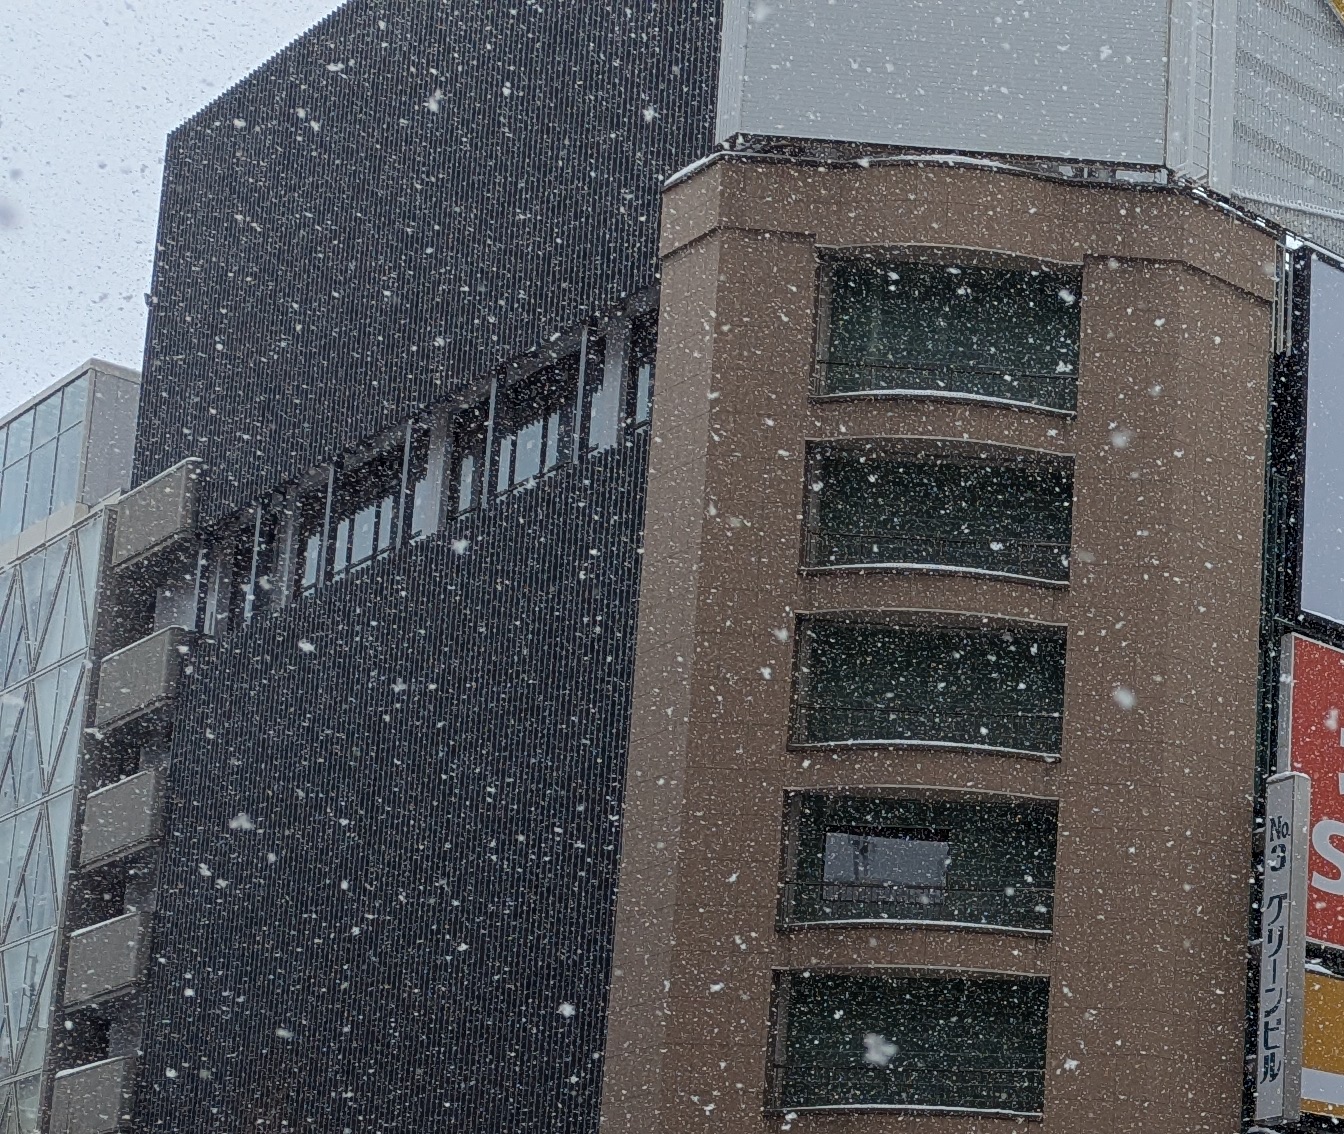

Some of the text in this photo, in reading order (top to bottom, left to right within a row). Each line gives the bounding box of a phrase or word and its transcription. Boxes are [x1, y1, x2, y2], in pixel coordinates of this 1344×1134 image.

[1259, 892, 1288, 1085] グリーンビル
